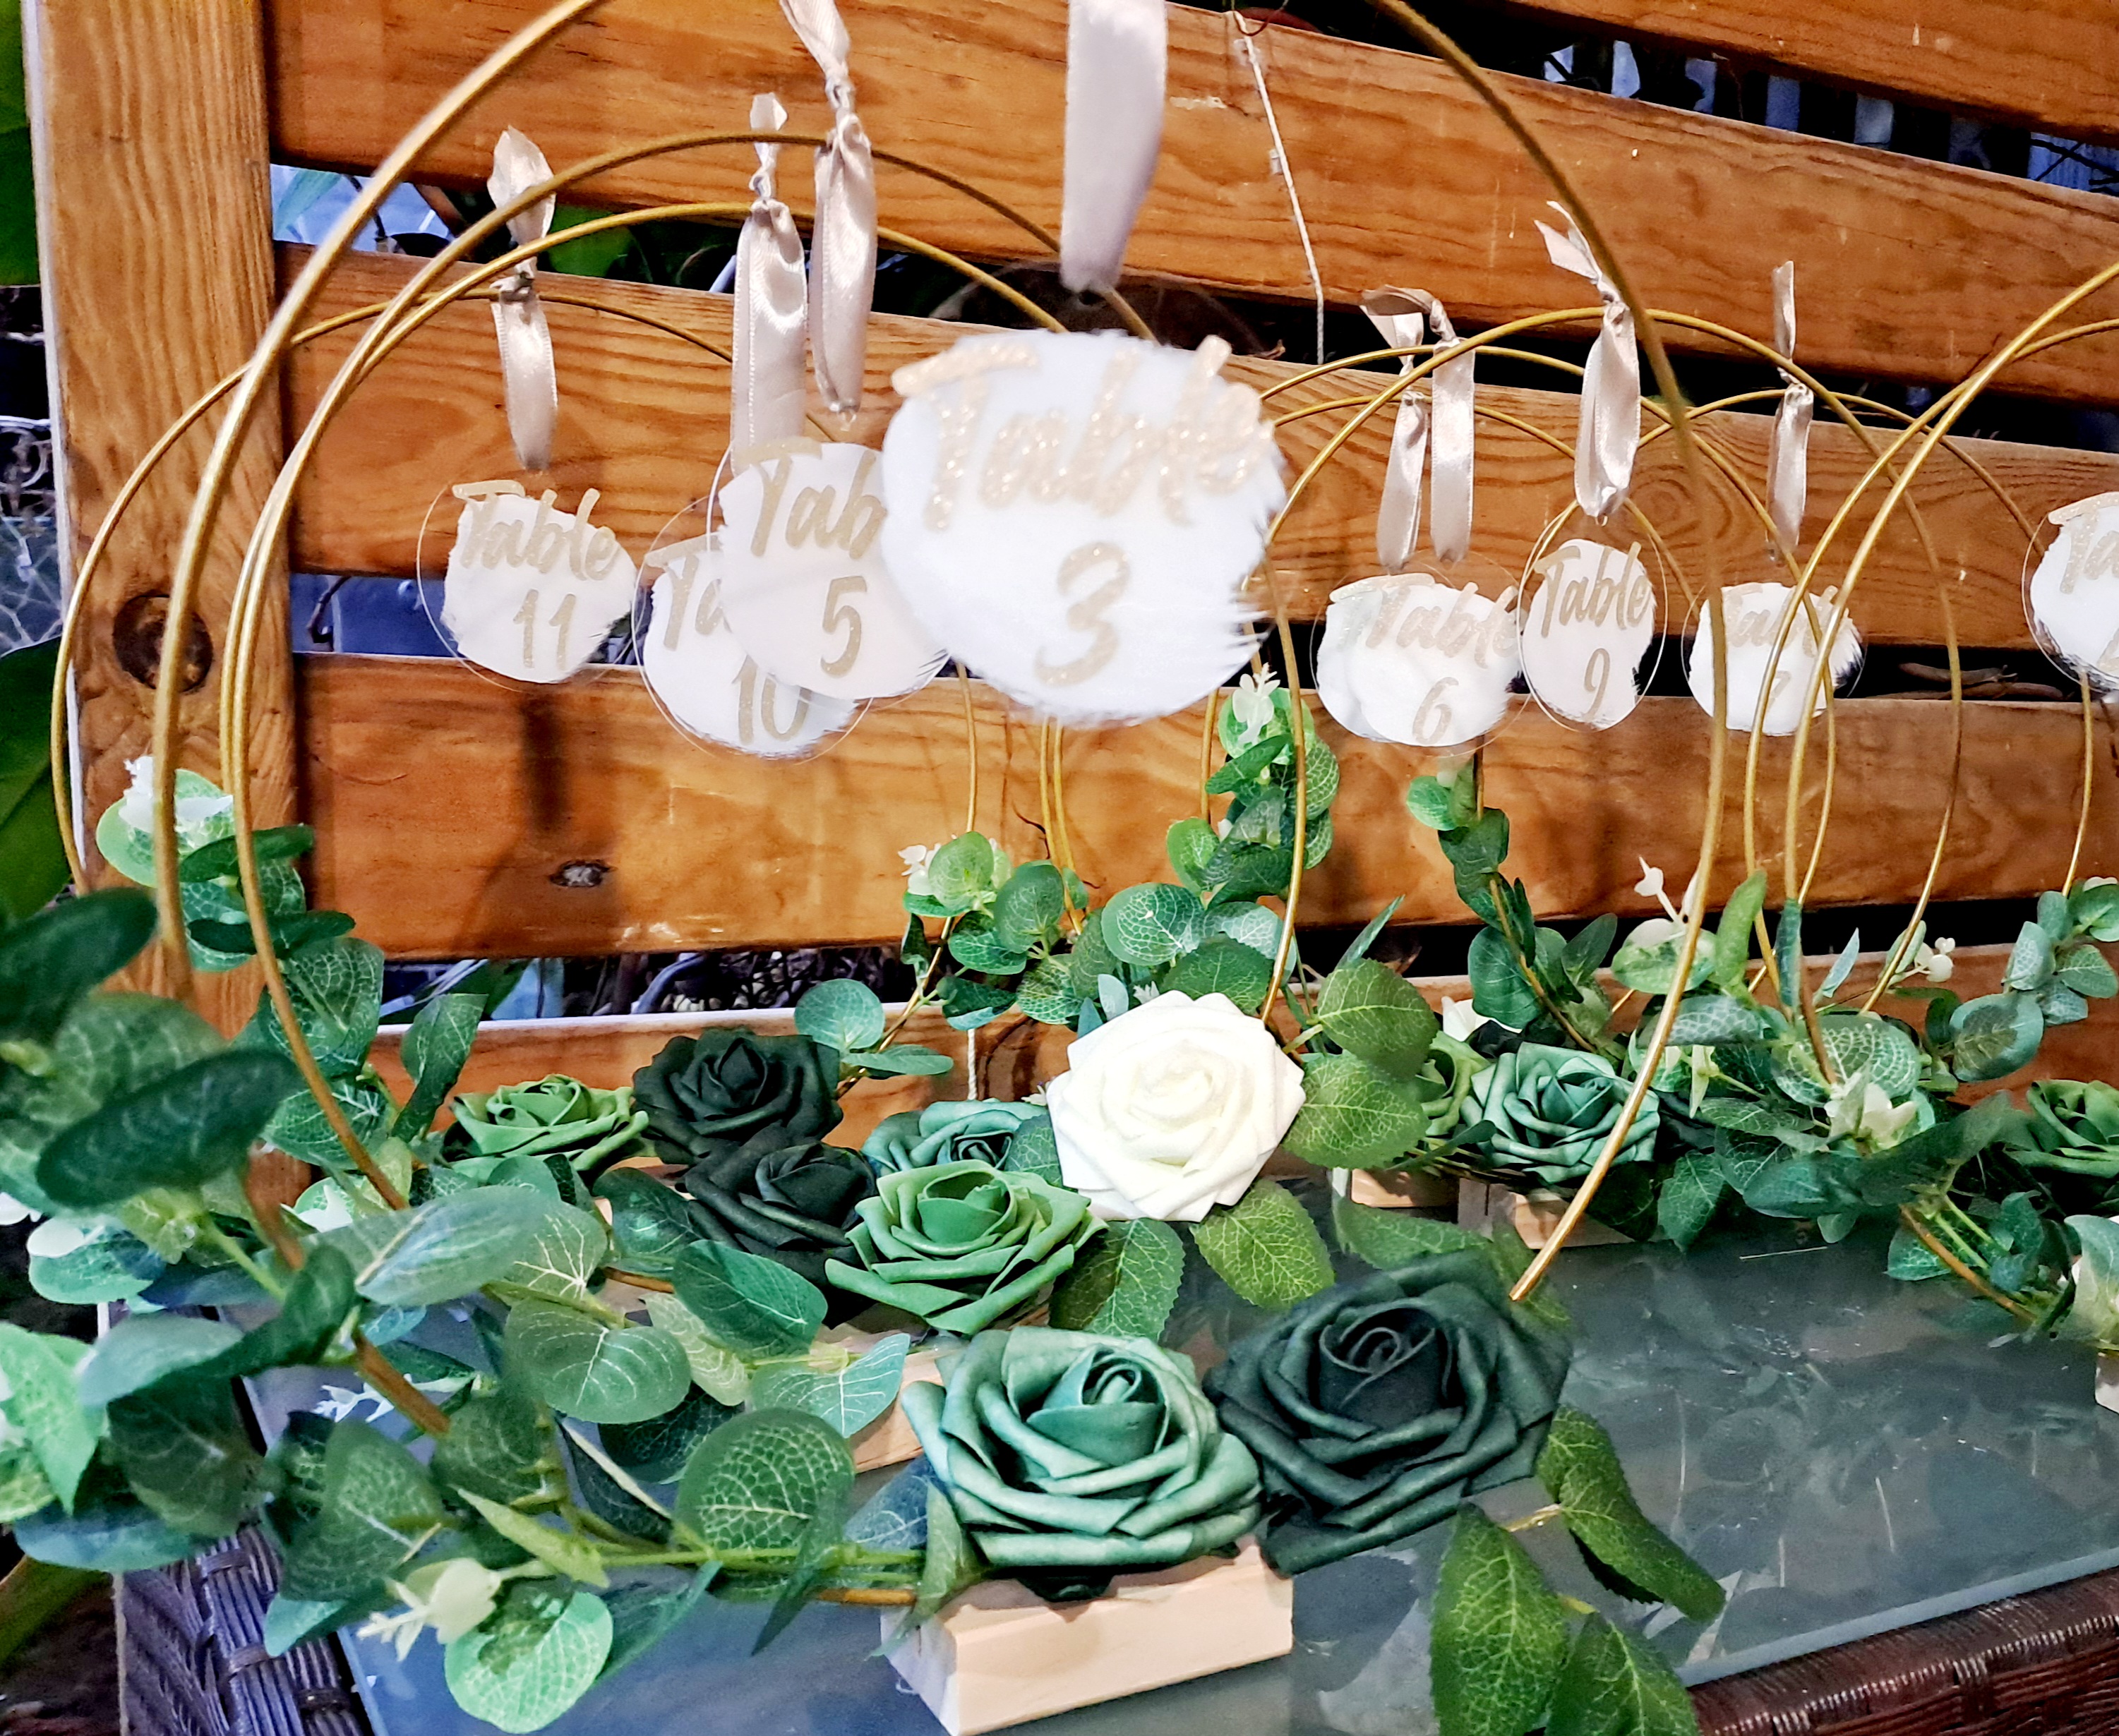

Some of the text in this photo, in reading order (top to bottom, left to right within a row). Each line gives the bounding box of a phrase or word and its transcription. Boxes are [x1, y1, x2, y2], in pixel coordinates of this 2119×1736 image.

[891, 334, 1275, 535] Table
[452, 479, 621, 581] Table
[733, 437, 889, 559] Tab
[512, 589, 577, 669] 11
[820, 576, 868, 678] 5
[1033, 541, 1131, 687] 3
[1362, 572, 1528, 670] Table
[1534, 541, 1652, 639] Table
[1412, 676, 1459, 745] 6
[1584, 647, 1611, 726] 9
